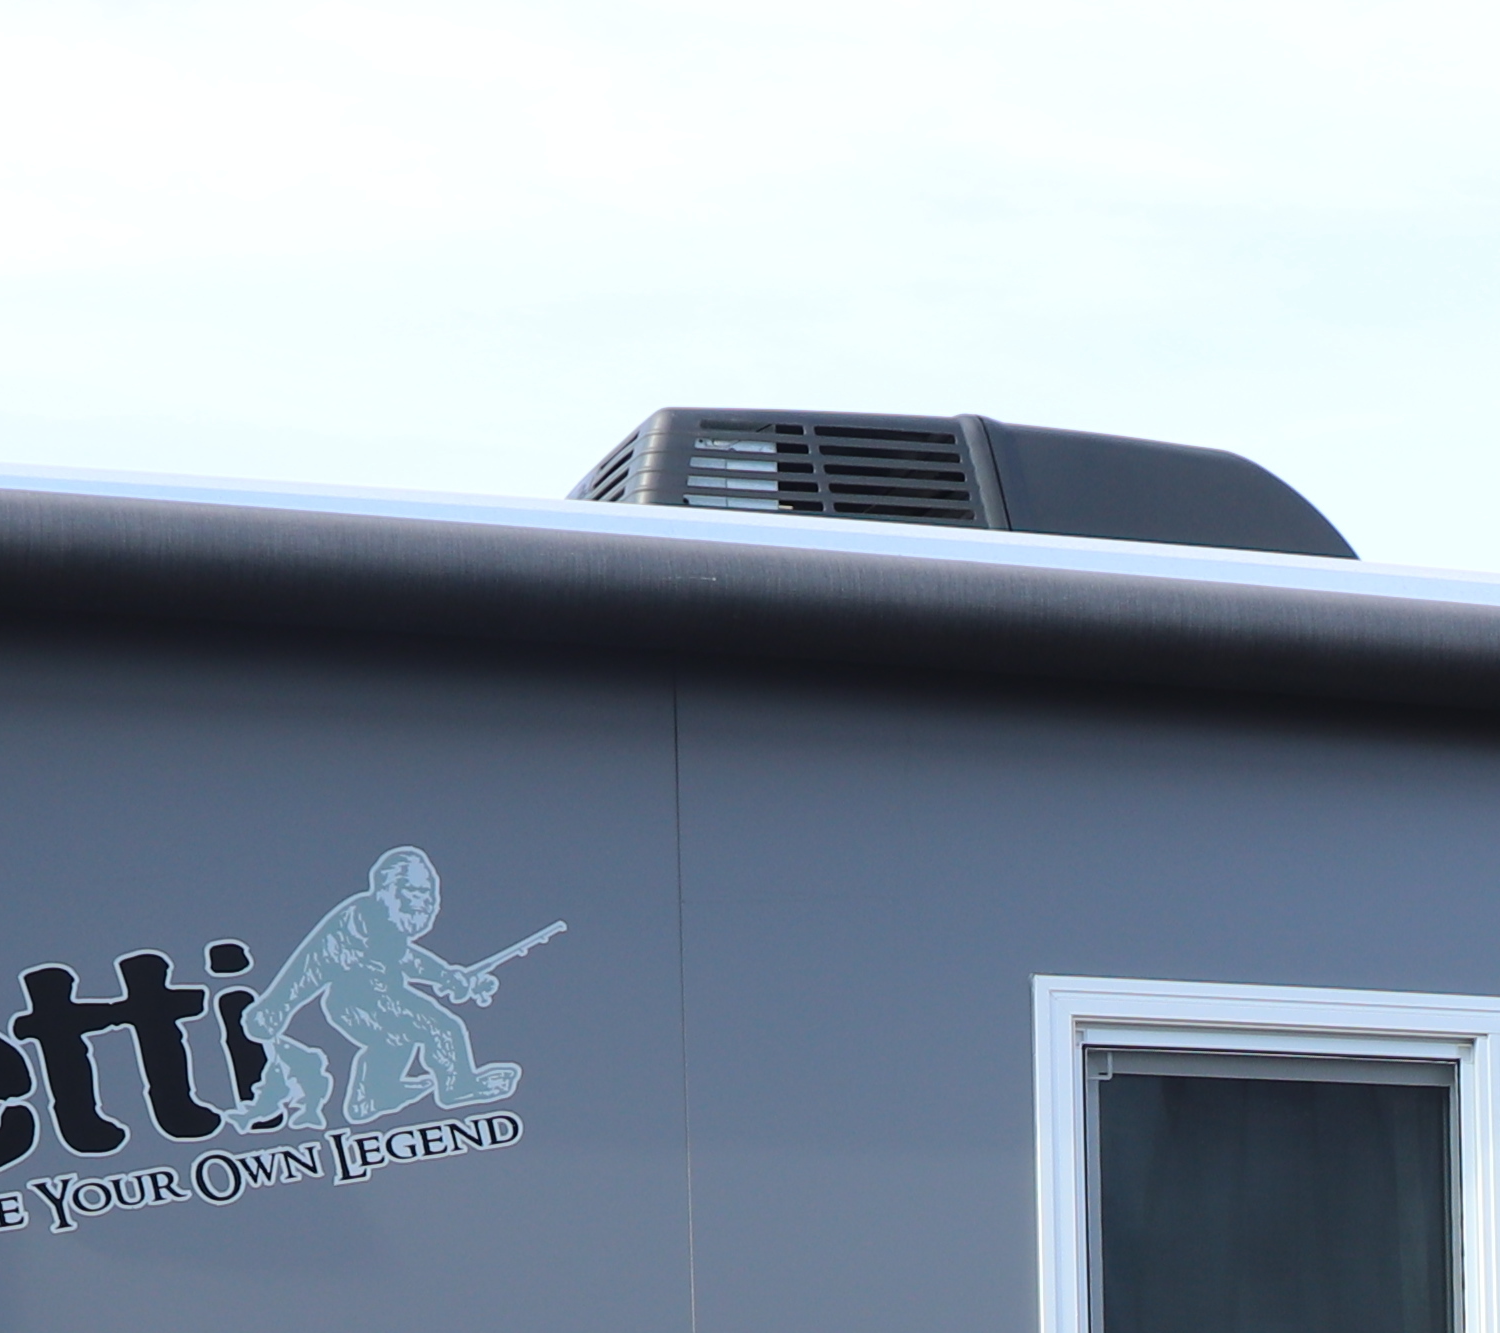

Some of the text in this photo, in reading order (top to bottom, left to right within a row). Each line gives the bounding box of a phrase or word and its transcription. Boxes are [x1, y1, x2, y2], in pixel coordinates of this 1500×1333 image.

[31, 1168, 190, 1232] YOUR
[191, 1143, 323, 1204] OWN
[326, 1112, 523, 1185] LEGEND
